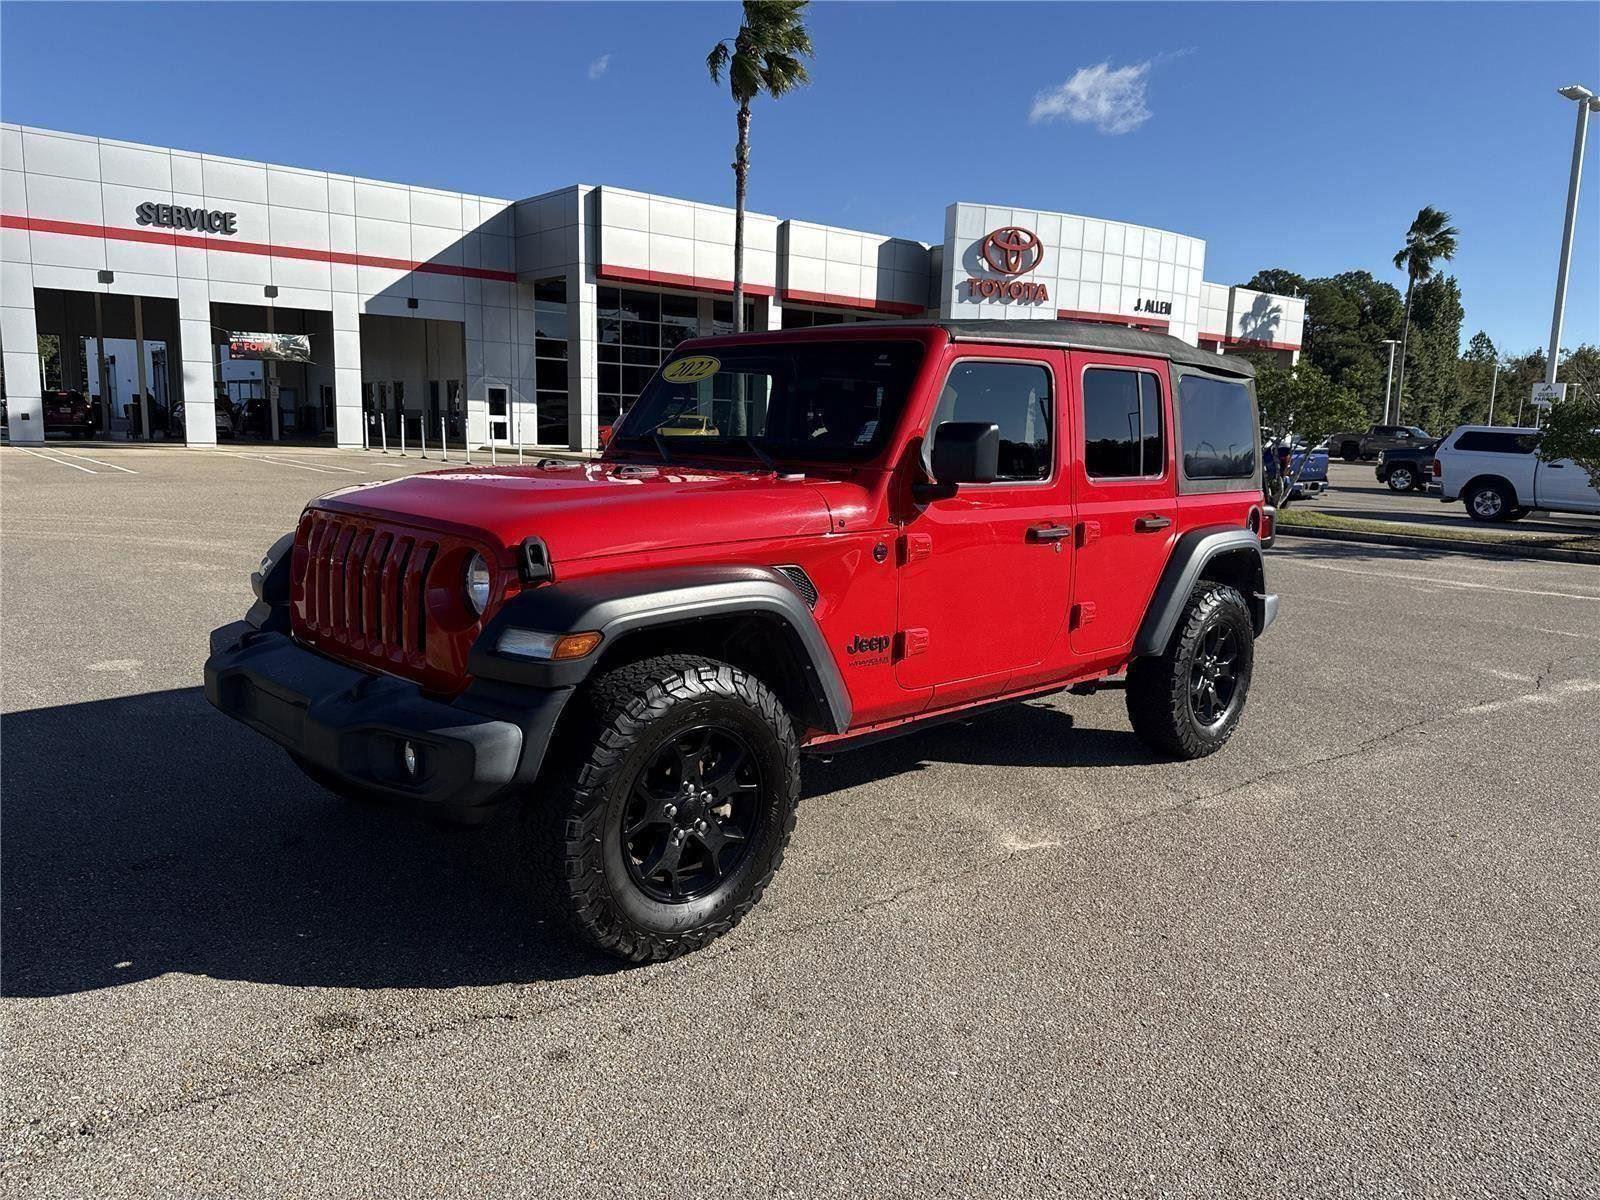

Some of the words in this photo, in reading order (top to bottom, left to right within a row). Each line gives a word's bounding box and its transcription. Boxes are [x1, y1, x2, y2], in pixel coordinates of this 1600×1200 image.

[137, 202, 237, 235] SERVICE
[967, 278, 1049, 302] TOYOTA
[1134, 298, 1143, 311] J.
[1144, 299, 1172, 315] ALLEN
[669, 361, 714, 377] 2022
[847, 635, 890, 655] Jeep
